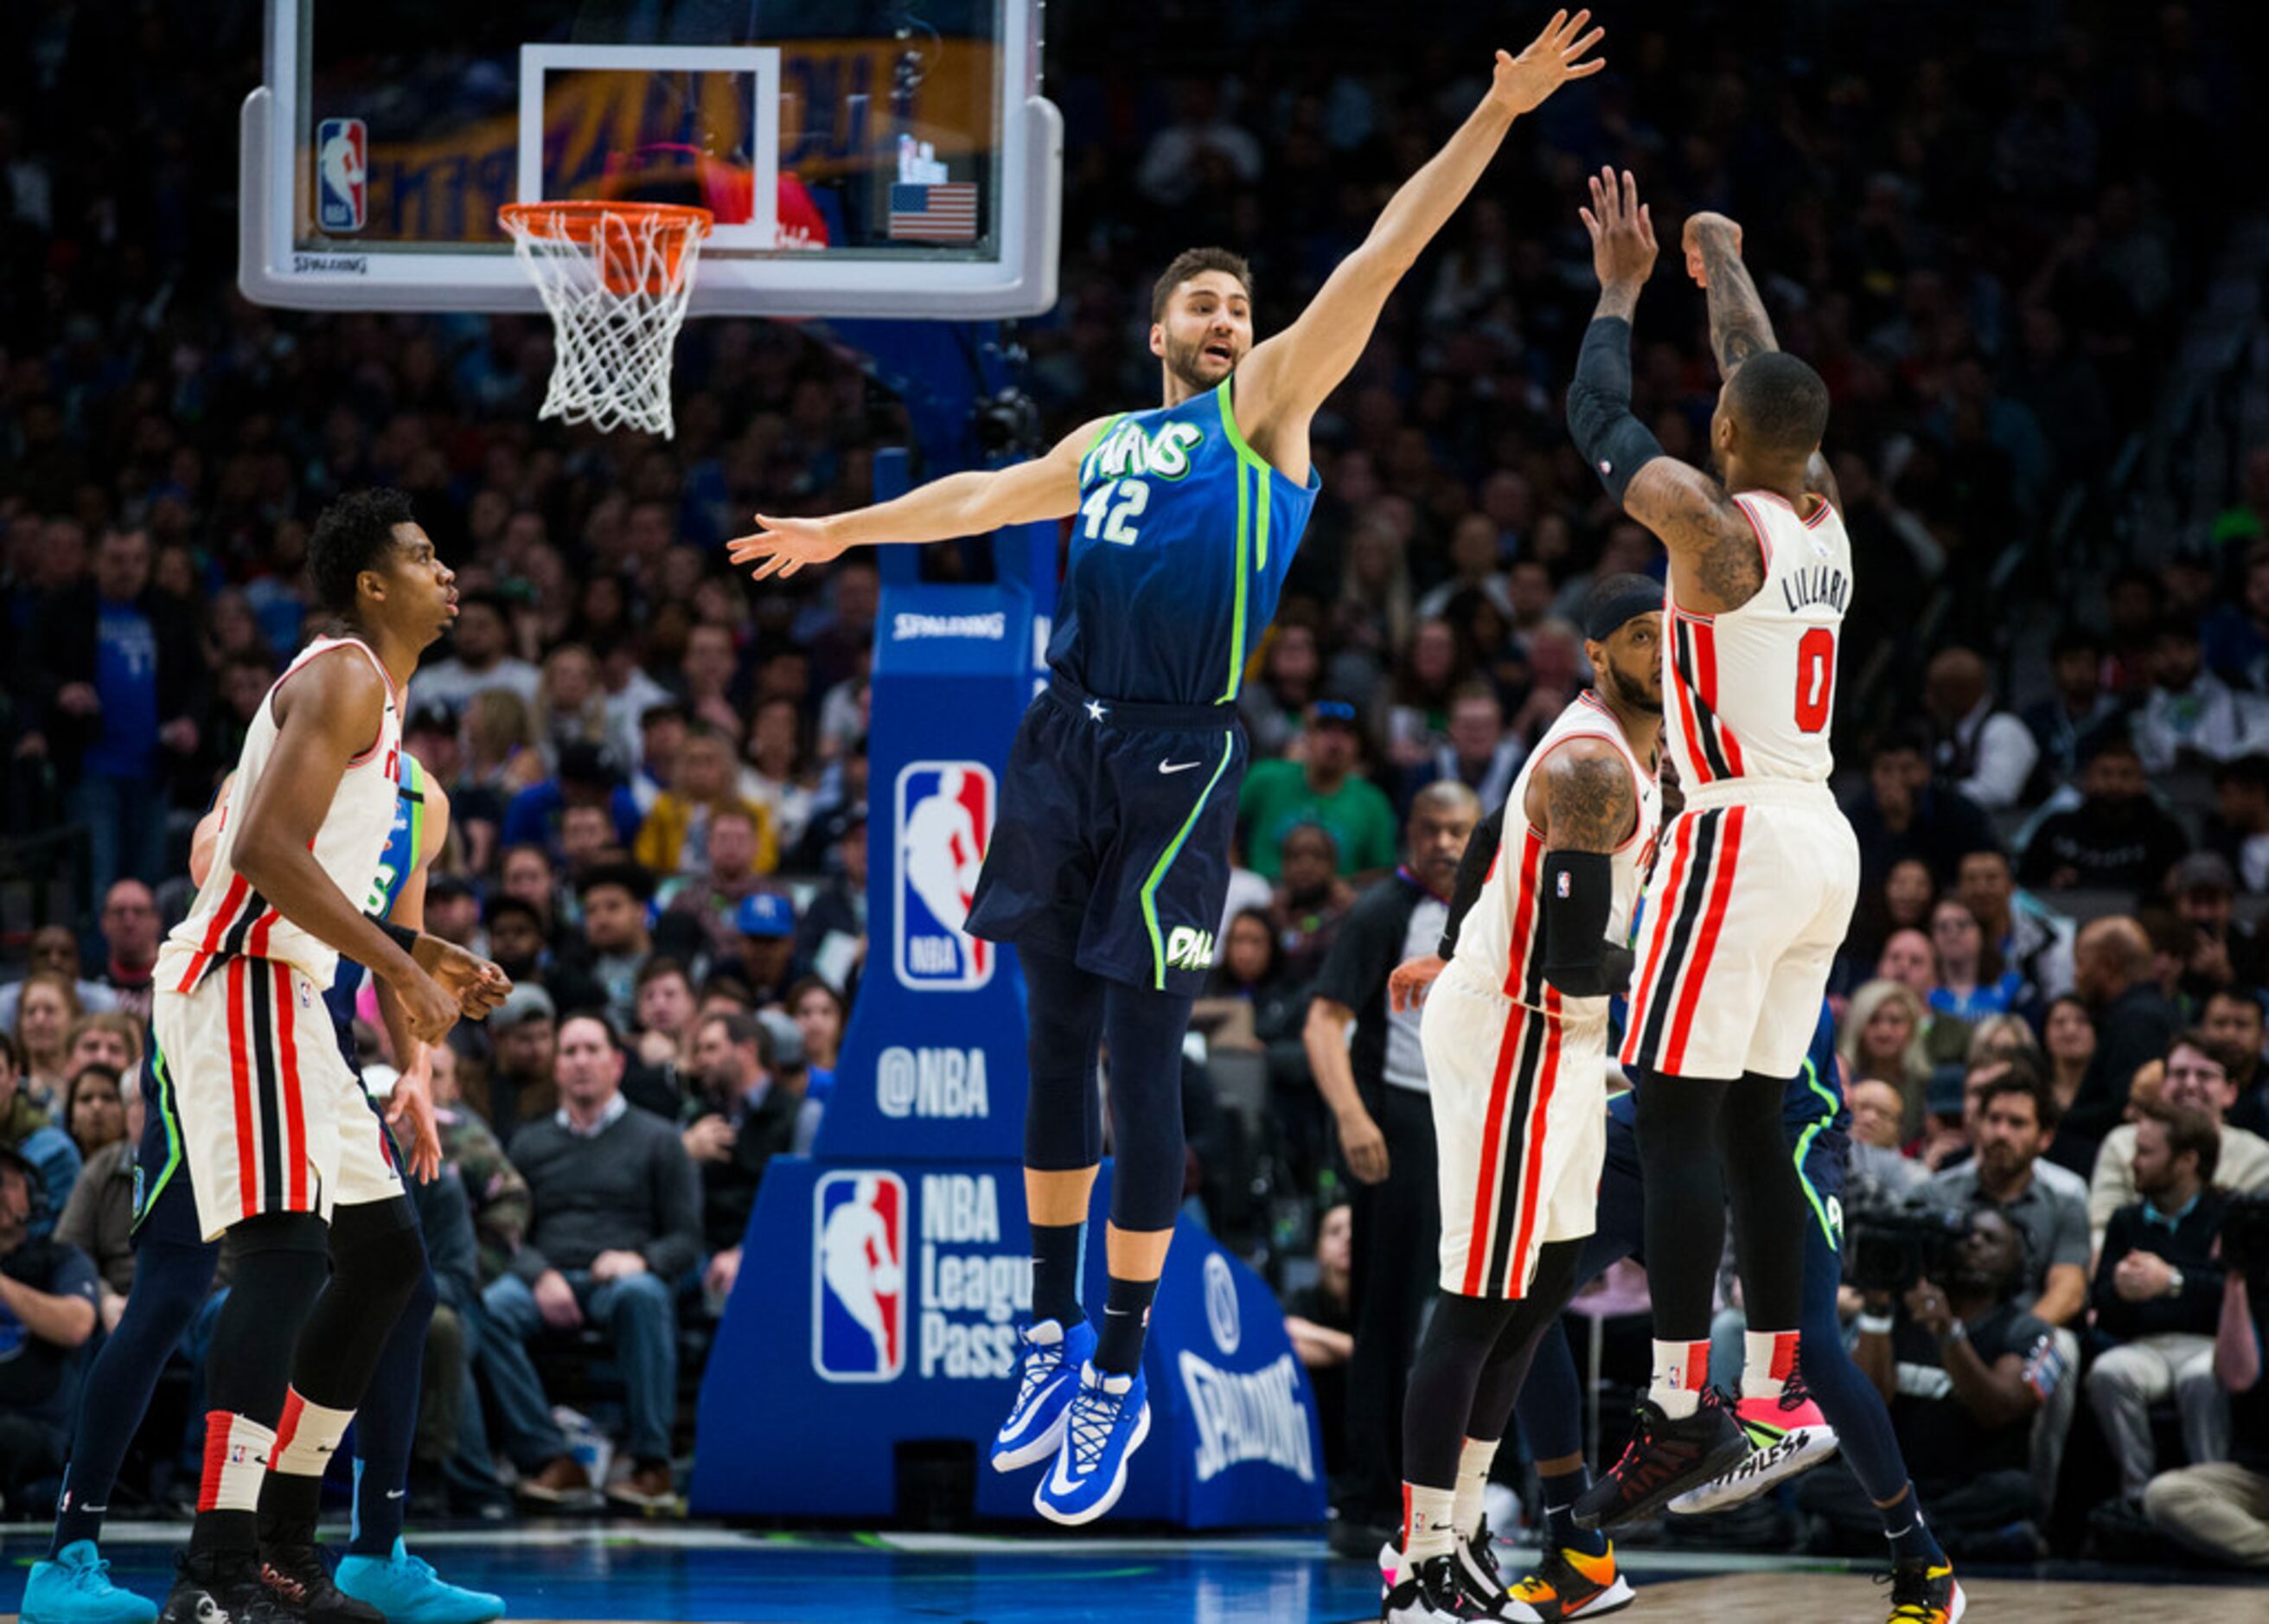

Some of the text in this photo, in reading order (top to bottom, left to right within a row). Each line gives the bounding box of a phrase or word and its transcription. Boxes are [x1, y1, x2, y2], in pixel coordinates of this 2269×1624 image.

[1081, 421, 1204, 486] MAVS
[1081, 479, 1150, 546] 42
[892, 611, 1006, 641] SPALDING
[1794, 627, 1835, 733] 0
[909, 936, 958, 975] NBA
[877, 1045, 989, 1118] @NBA
[921, 1174, 1000, 1243] NBA
[921, 1243, 1033, 1322] Leagu
[920, 1310, 1017, 1378] Pass
[1178, 1349, 1315, 1482] SPALDING
[1712, 1429, 1811, 1487] HLESS
